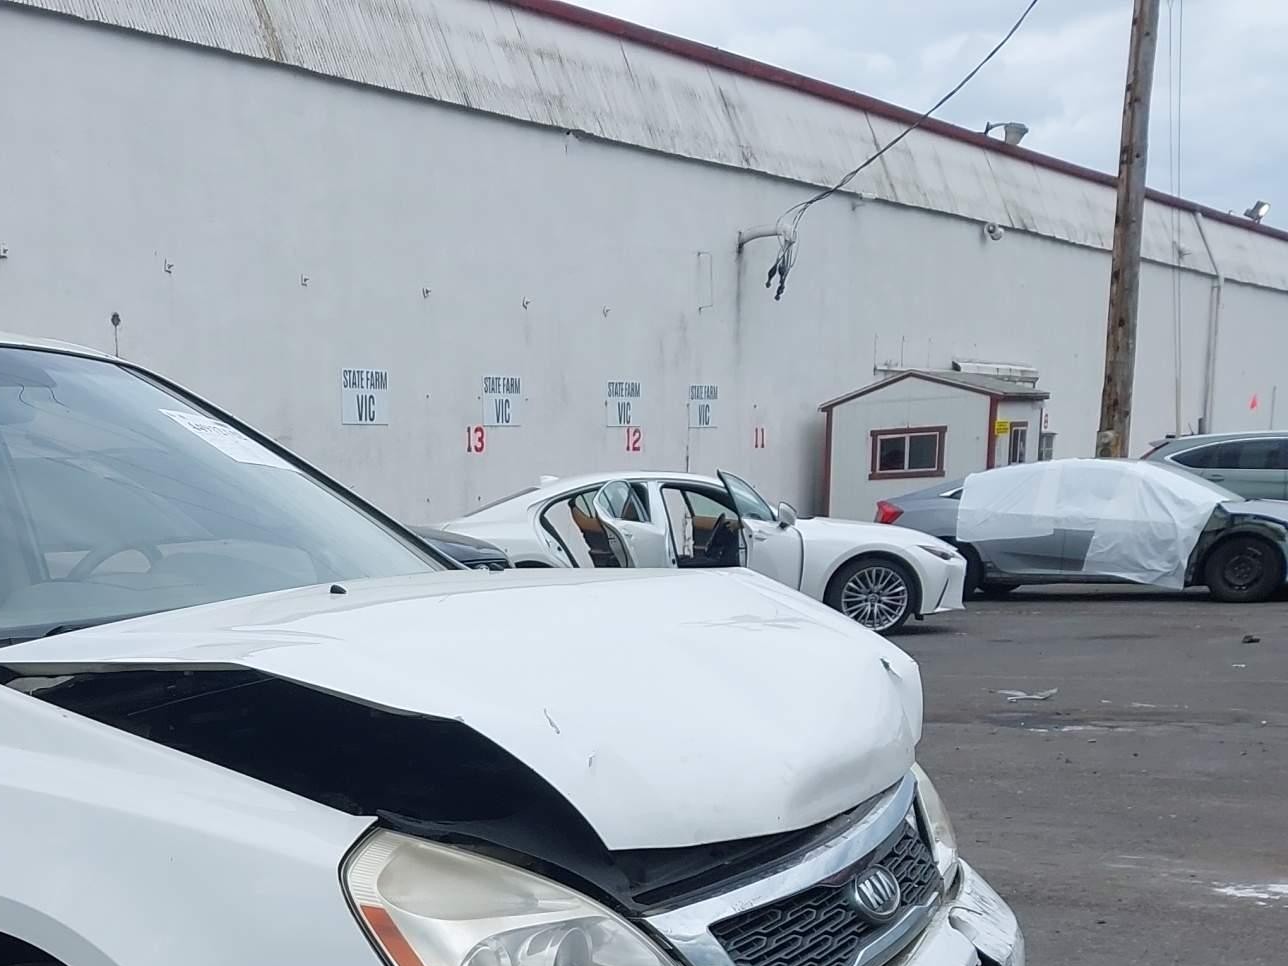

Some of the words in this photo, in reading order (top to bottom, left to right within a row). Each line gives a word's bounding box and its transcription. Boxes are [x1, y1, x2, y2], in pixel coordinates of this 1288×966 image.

[343, 369, 365, 389] STATE
[366, 370, 388, 390] FARM
[484, 376, 502, 394] STATE
[502, 377, 521, 394] FARM
[607, 381, 624, 398] STATE
[624, 382, 641, 398] FARM
[356, 394, 376, 422] VIC
[494, 398, 511, 424] VIC
[617, 401, 632, 425] VIC
[698, 403, 710, 426] VIC
[466, 426, 485, 453] 13
[626, 427, 642, 452] 12
[754, 427, 765, 449] 11
[858, 870, 897, 909] KIA
